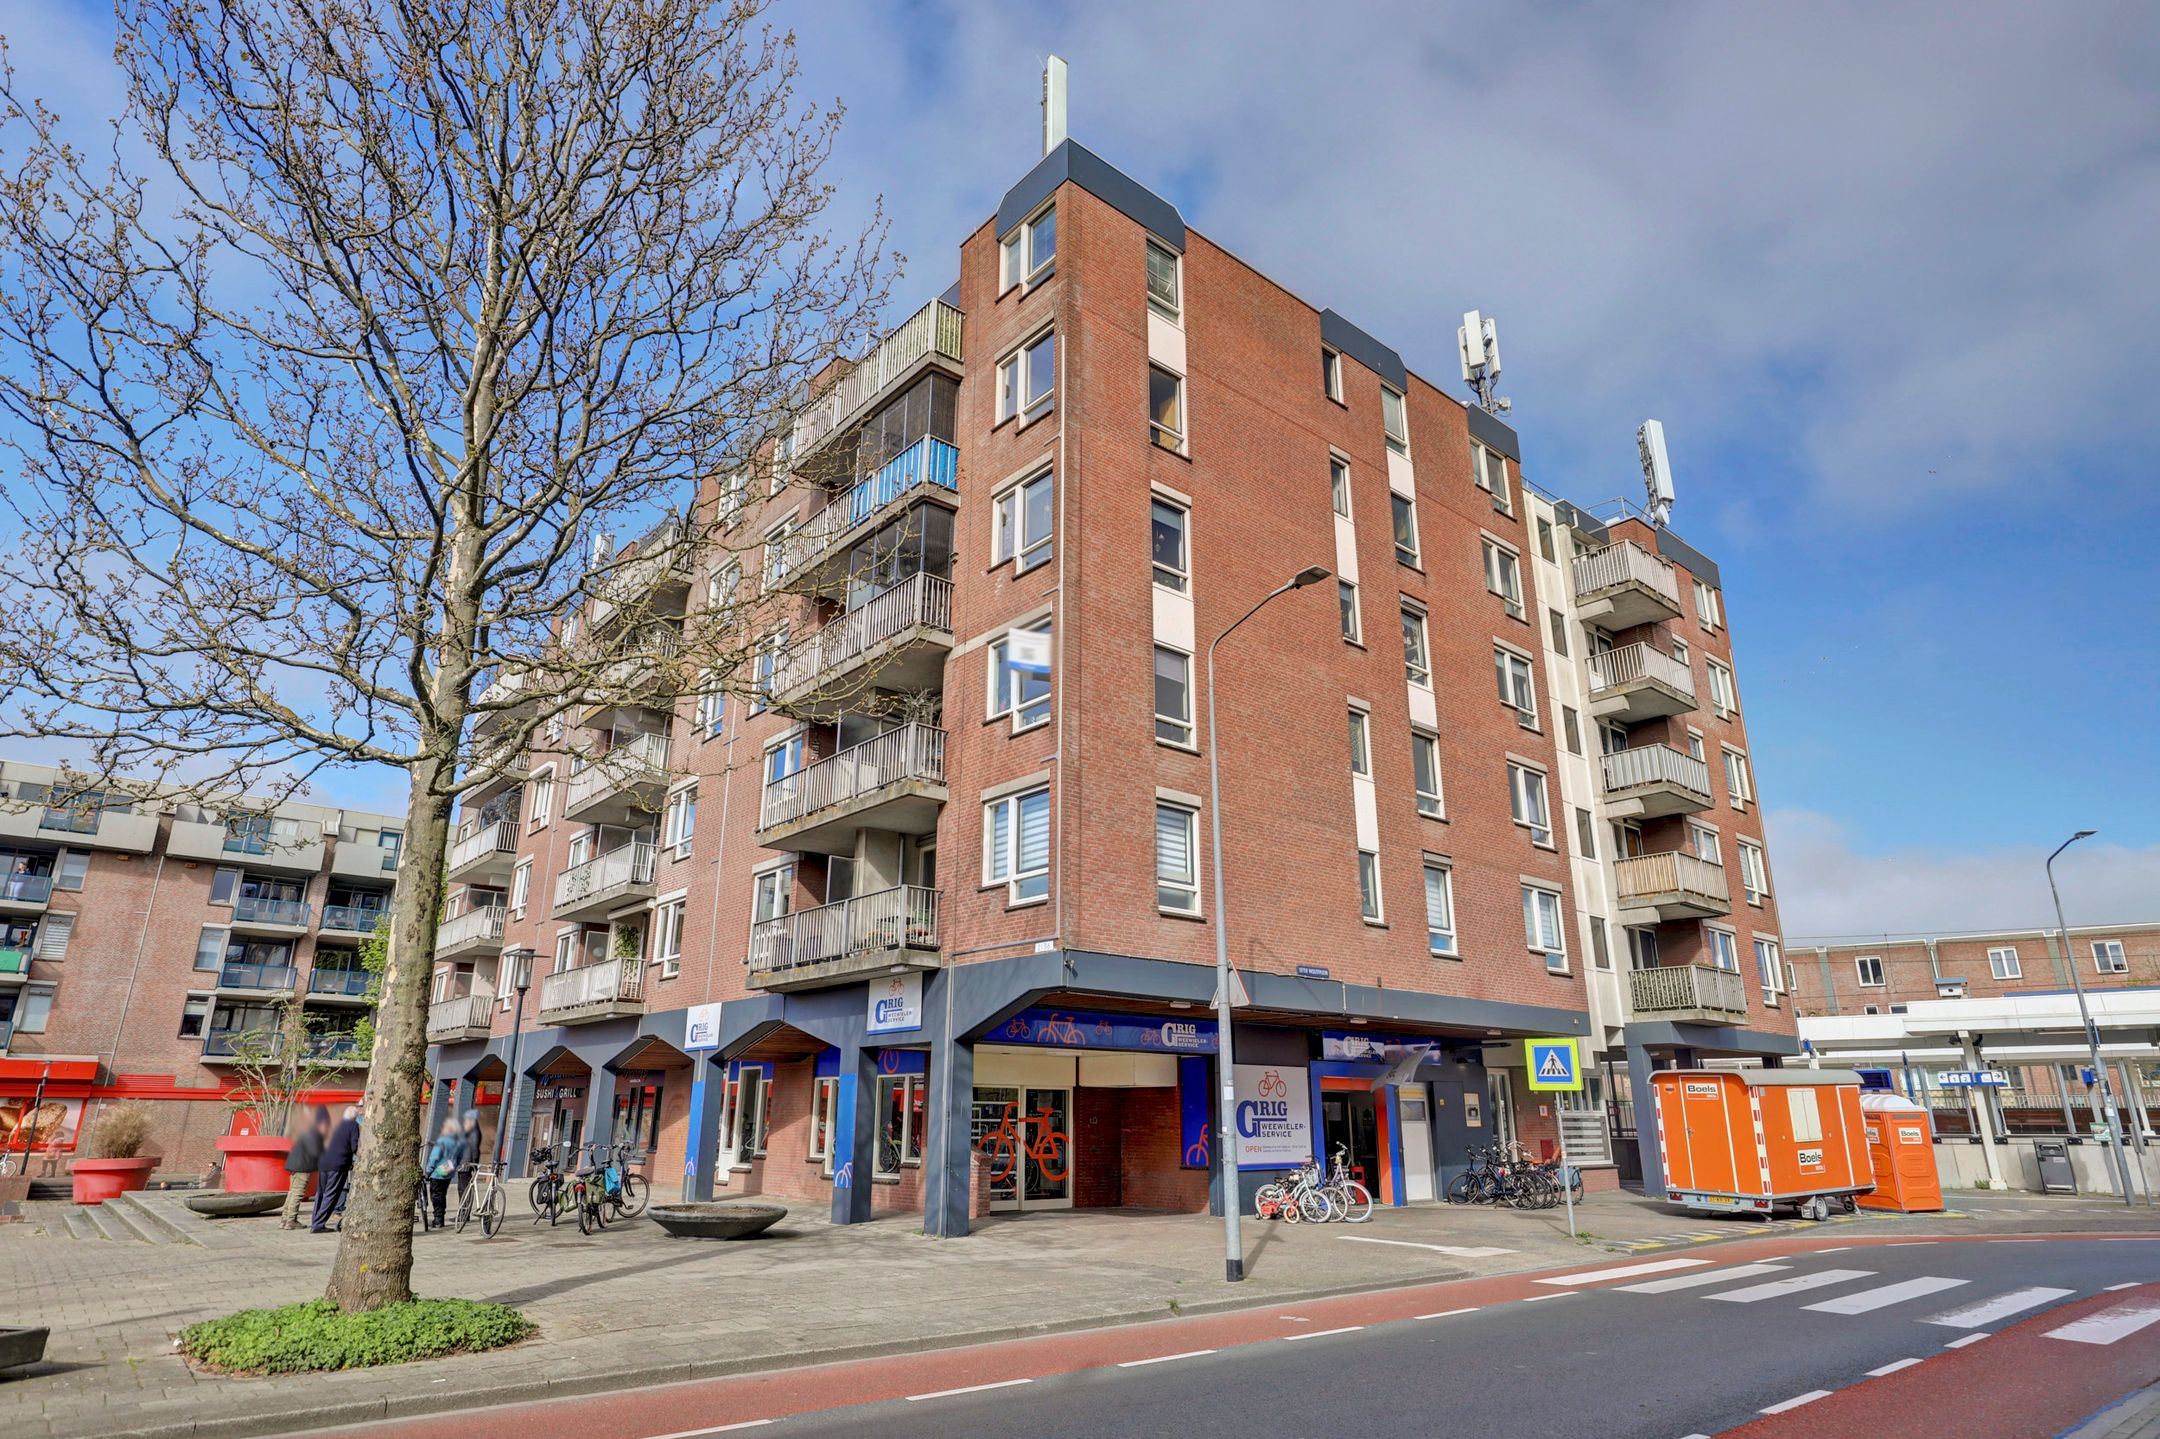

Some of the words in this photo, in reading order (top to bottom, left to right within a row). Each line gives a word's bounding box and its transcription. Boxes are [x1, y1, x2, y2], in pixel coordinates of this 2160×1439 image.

[875, 997, 904, 1024] GRIG
[1161, 1022, 1196, 1047] GRIG
[536, 1088, 554, 1099] SUSHI
[559, 1087, 577, 1098] GRILL
[1236, 1100, 1288, 1138] GRIG
[1262, 1130, 1292, 1138] SERVICE
[1245, 1145, 1262, 1153] OPEN
[1799, 1152, 1822, 1163] Boels
